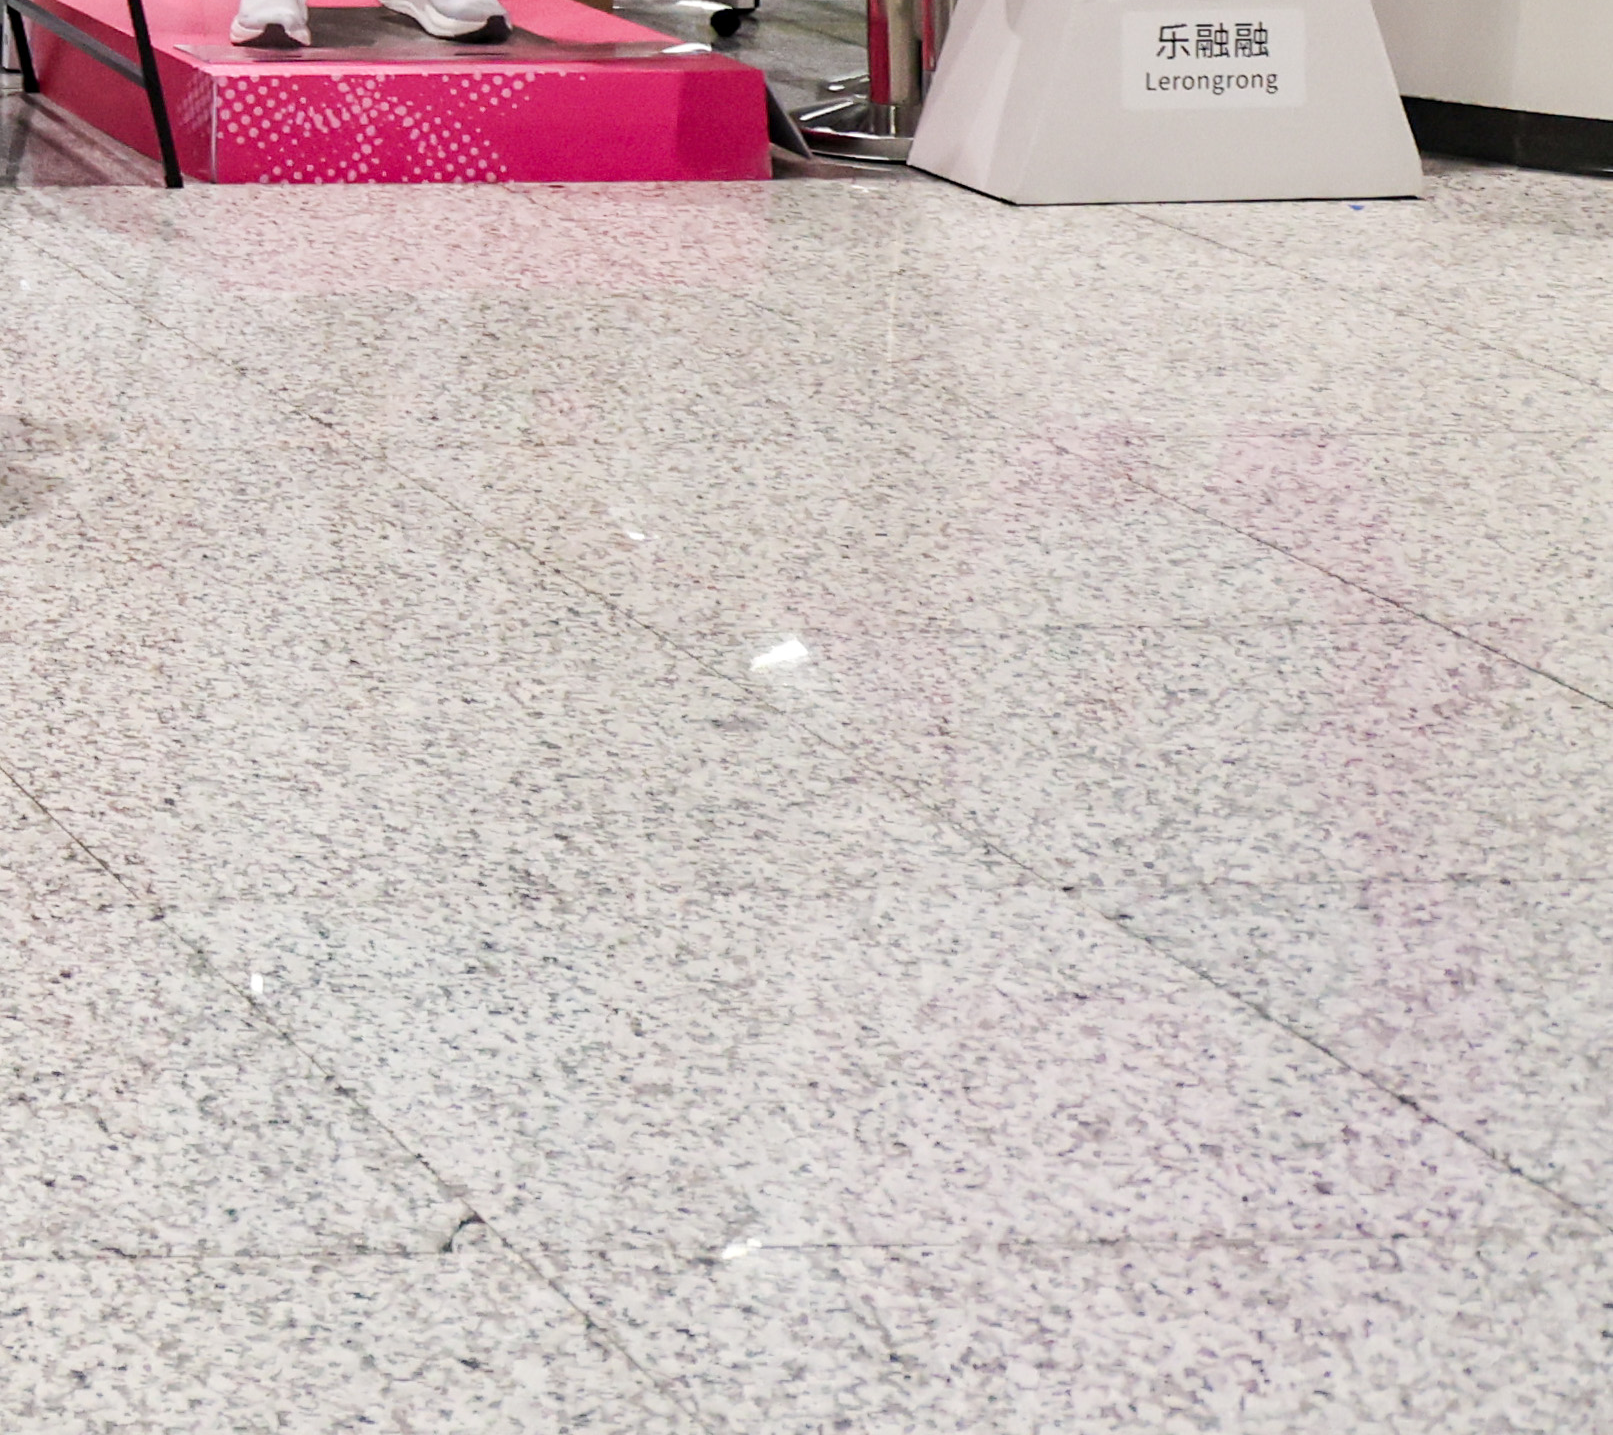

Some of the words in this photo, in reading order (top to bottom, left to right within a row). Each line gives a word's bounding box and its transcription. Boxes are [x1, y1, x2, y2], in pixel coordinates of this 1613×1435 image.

[1155, 21, 1270, 60] 乐融融
[1145, 71, 1279, 96] Lerongrong
